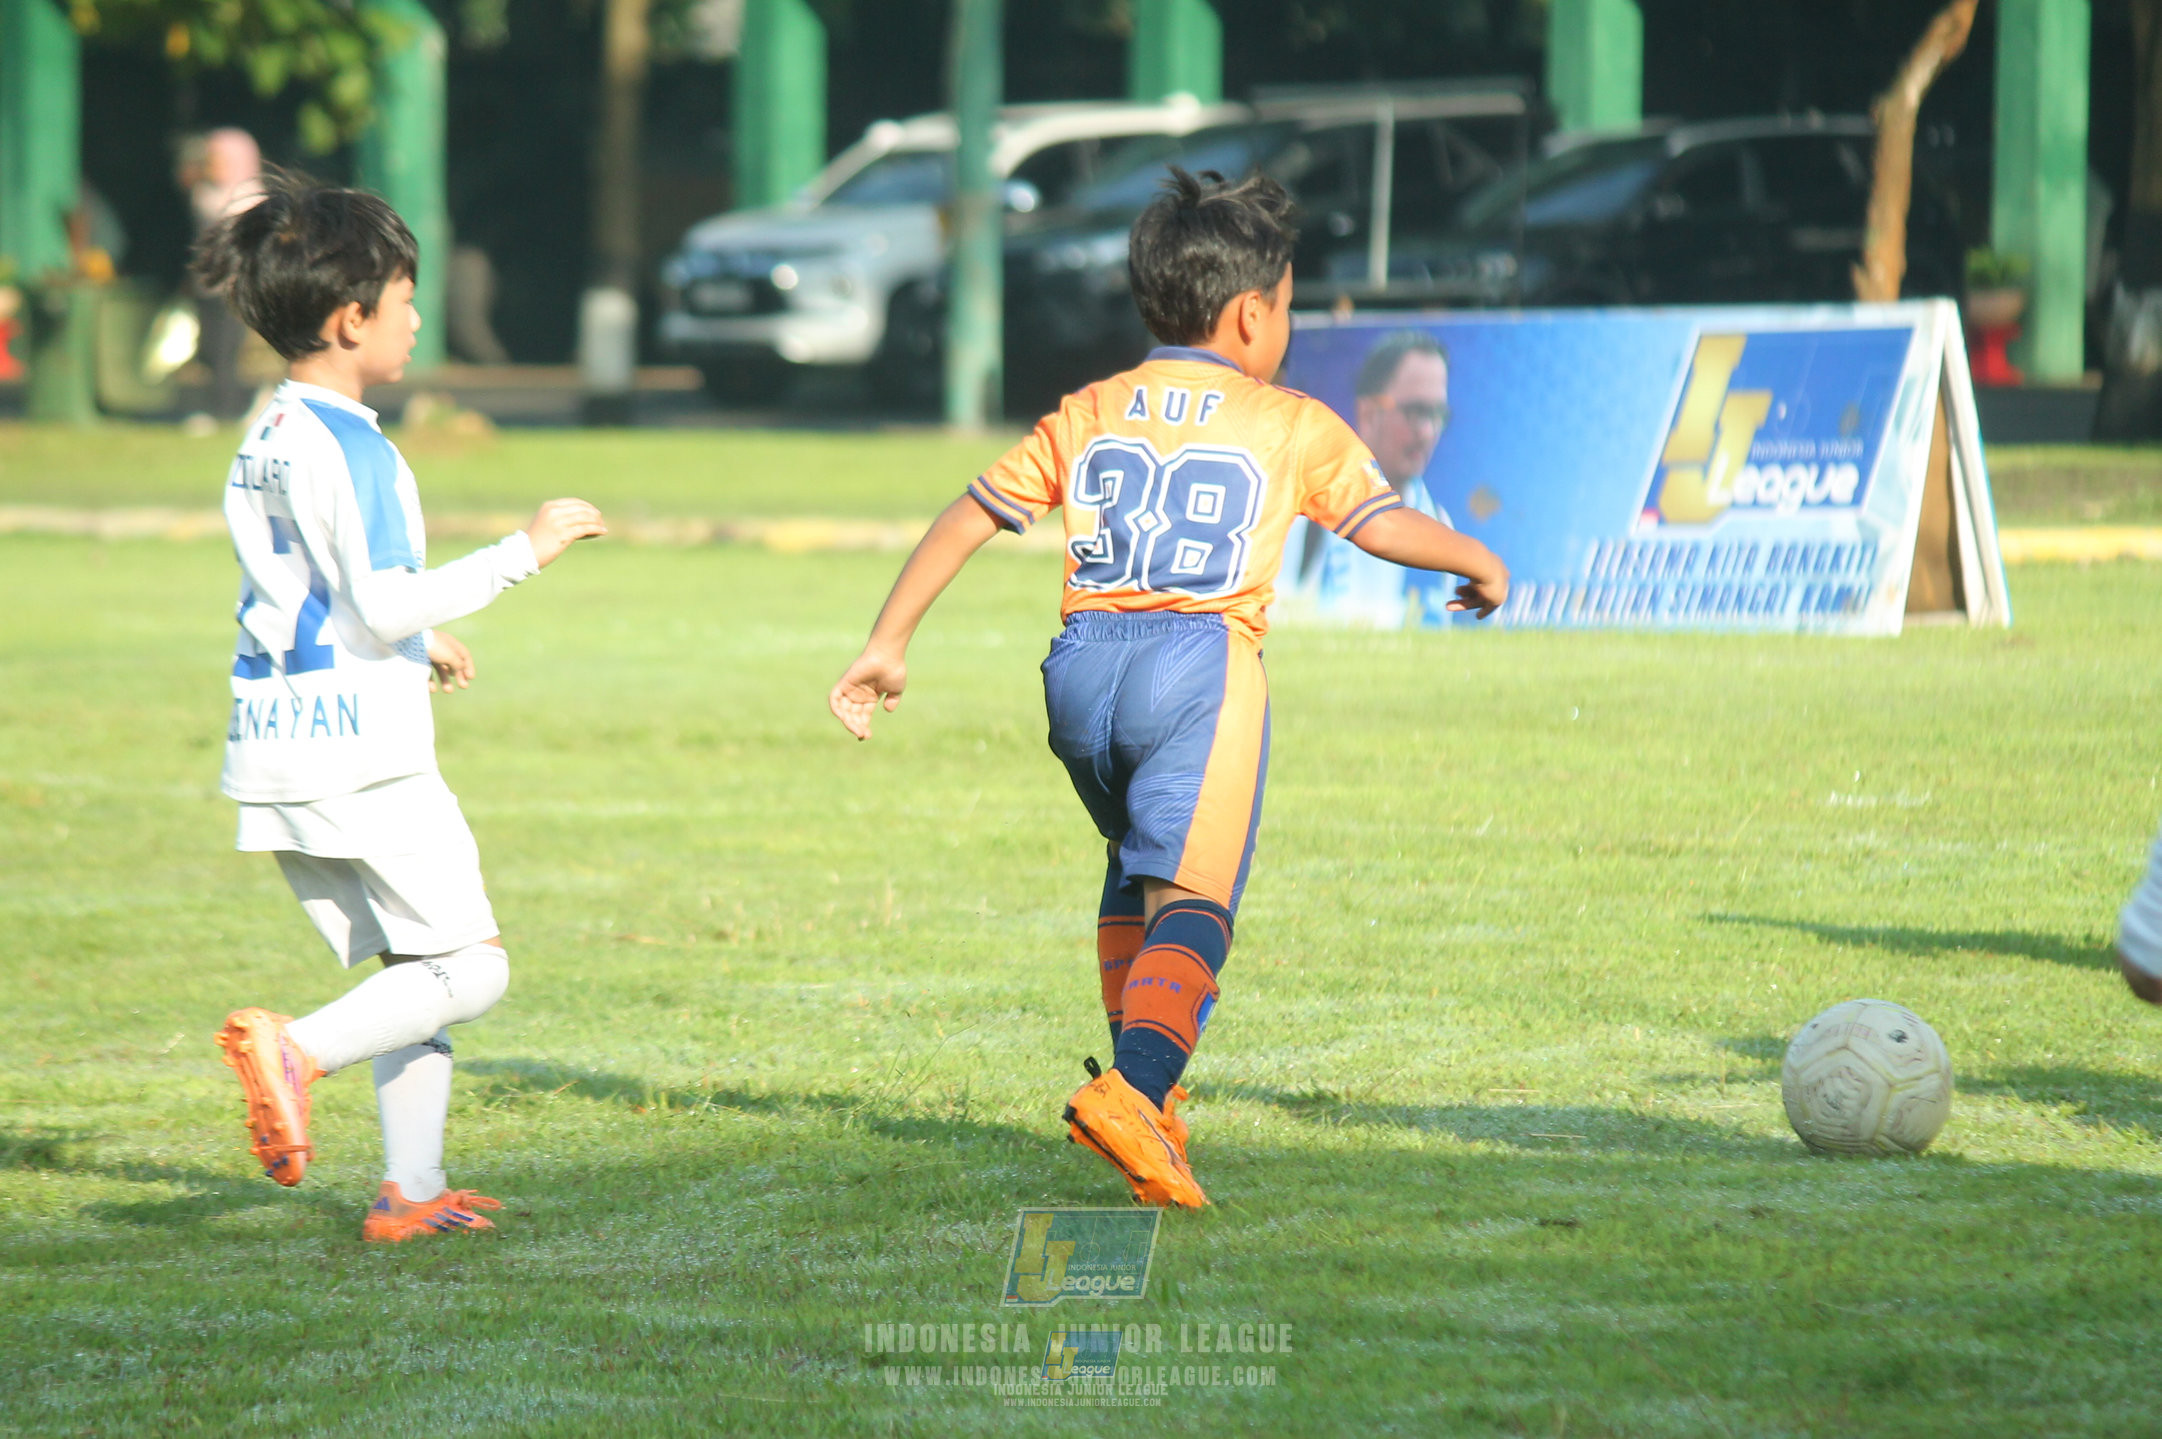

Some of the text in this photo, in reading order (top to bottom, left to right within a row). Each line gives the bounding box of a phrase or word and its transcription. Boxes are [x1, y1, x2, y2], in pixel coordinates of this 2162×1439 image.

[1125, 384, 1225, 426] AUF
[1068, 433, 1268, 600] 38
[1706, 451, 1860, 518] League
